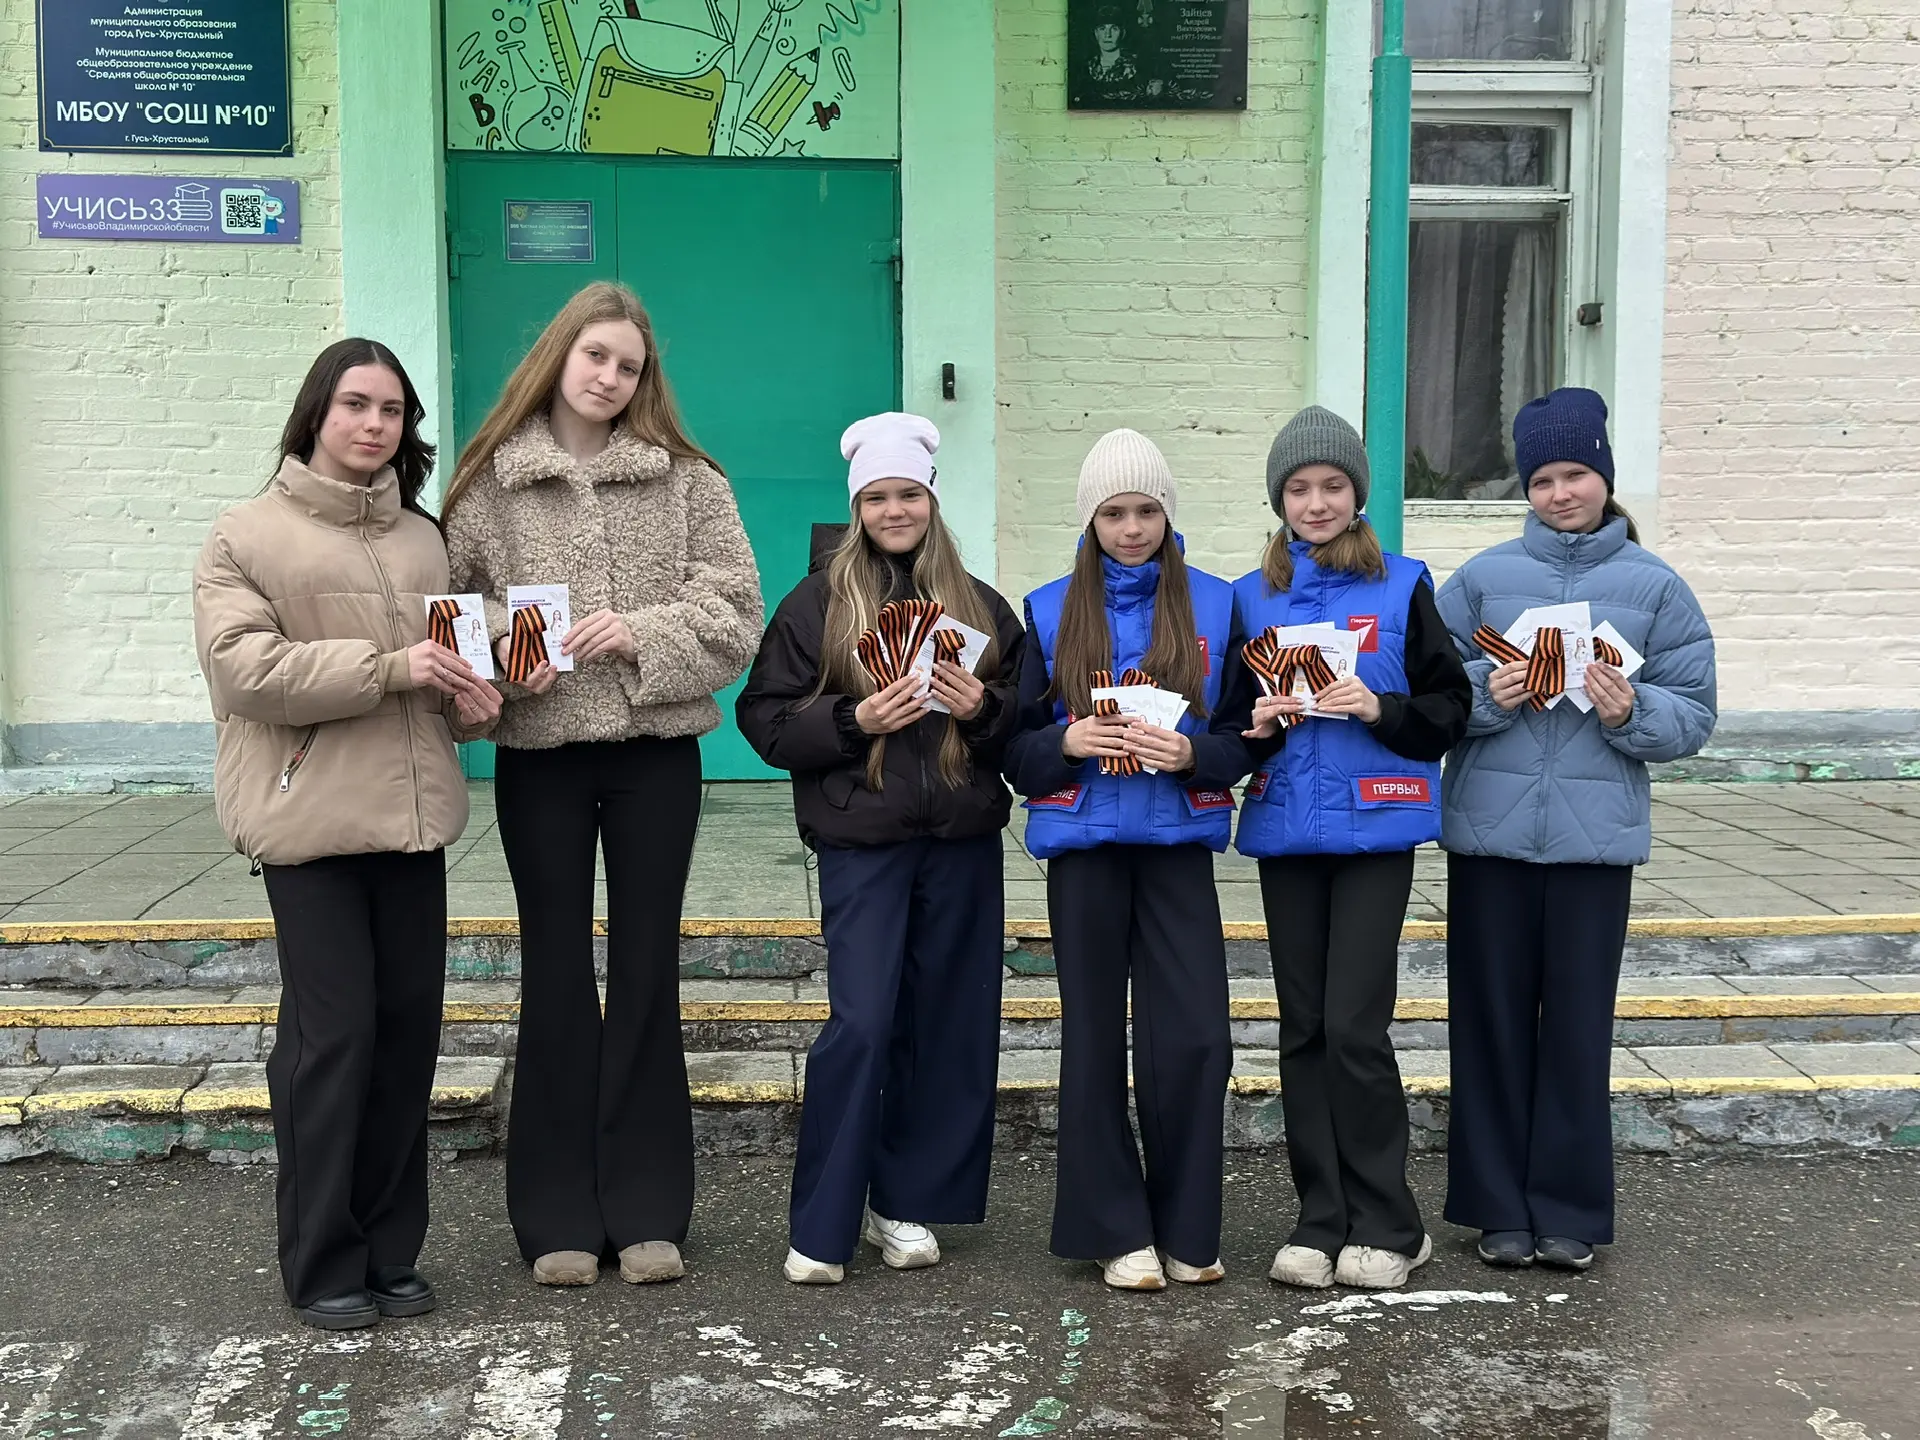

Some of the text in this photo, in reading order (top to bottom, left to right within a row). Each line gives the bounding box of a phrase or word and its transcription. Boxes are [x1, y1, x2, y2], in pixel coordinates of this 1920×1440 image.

[124, 6, 203, 17] Администрация
[90, 17, 237, 29] муниципального образования
[104, 29, 223, 40] город Гусь-Хрустальный
[95, 47, 234, 60] Муниципальное бюджетное
[76, 58, 253, 72] общеобразовательное учреждение
[133, 71, 245, 82] общеобразовательная
[135, 82, 167, 91] школа
[169, 83, 180, 91] №
[56, 101, 276, 126] МБОУ "СОШ №10"
[131, 134, 209, 144] Гусь-Хрустальный
[44, 196, 182, 221] УЧИСЬ33
[52, 221, 210, 232] #УчисьвоВладимирскойобласти
[1372, 783, 1421, 796] ПЕРВЫХ
